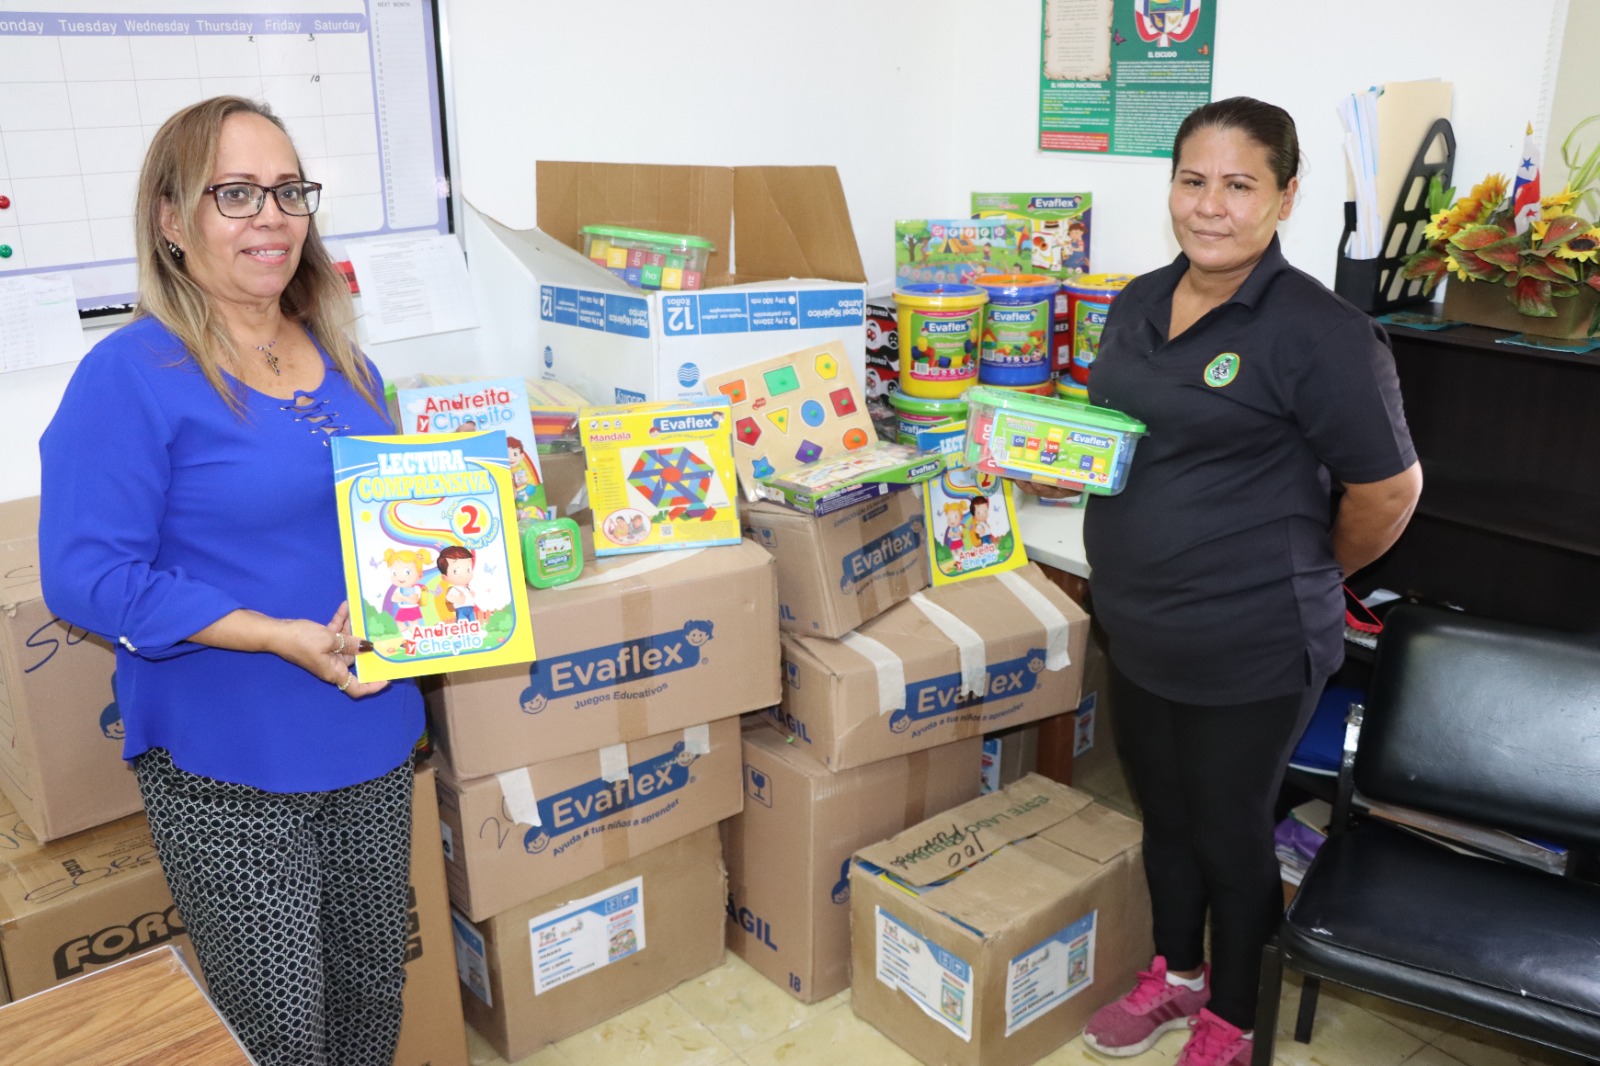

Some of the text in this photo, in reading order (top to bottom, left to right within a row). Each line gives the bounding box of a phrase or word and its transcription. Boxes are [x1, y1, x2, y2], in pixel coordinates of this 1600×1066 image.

[57, 19, 118, 35] Tuesday
[124, 19, 190, 34] Wednesday
[196, 20, 253, 34] Thursday
[265, 20, 301, 34] Friday
[314, 20, 361, 33] Saturday
[308, 34, 315, 42] 3
[310, 75, 320, 83] 10
[1035, 198, 1074, 208] Evaflex
[541, 295, 553, 317] 12
[667, 298, 691, 306] Rollos
[838, 299, 862, 308] Jumbo
[842, 307, 863, 317] Papel
[667, 306, 695, 332] 12
[928, 322, 967, 333] Evaflex
[994, 311, 1031, 322] Evaflex
[425, 389, 510, 414] Andreita
[433, 407, 514, 431] Chepito
[660, 416, 713, 432] Evaflex
[589, 432, 632, 443] Mandala
[1073, 433, 1107, 447] Evaflex
[378, 449, 466, 475] LECTURA
[910, 463, 936, 477] Evaflex
[358, 471, 492, 501] COMPRENSIVA
[461, 505, 481, 535] 2
[851, 532, 913, 577] Evaflex
[959, 544, 995, 561] Andreita
[963, 552, 998, 570] Chepito
[412, 619, 481, 641] Andreita
[418, 634, 482, 655] Chepito
[550, 642, 684, 692] Evaflex
[574, 682, 669, 710] Juegos Educativos
[911, 720, 938, 739] Ayuda
[946, 714, 959, 724] tus
[960, 711, 981, 723] niños
[988, 702, 1024, 721] aprender
[552, 765, 674, 829] Evaflex
[1010, 794, 1050, 817] ESTE
[553, 798, 681, 857] Ayuda a tus niños a aprender
[964, 812, 1013, 834] LADO
[788, 971, 802, 993] 18
